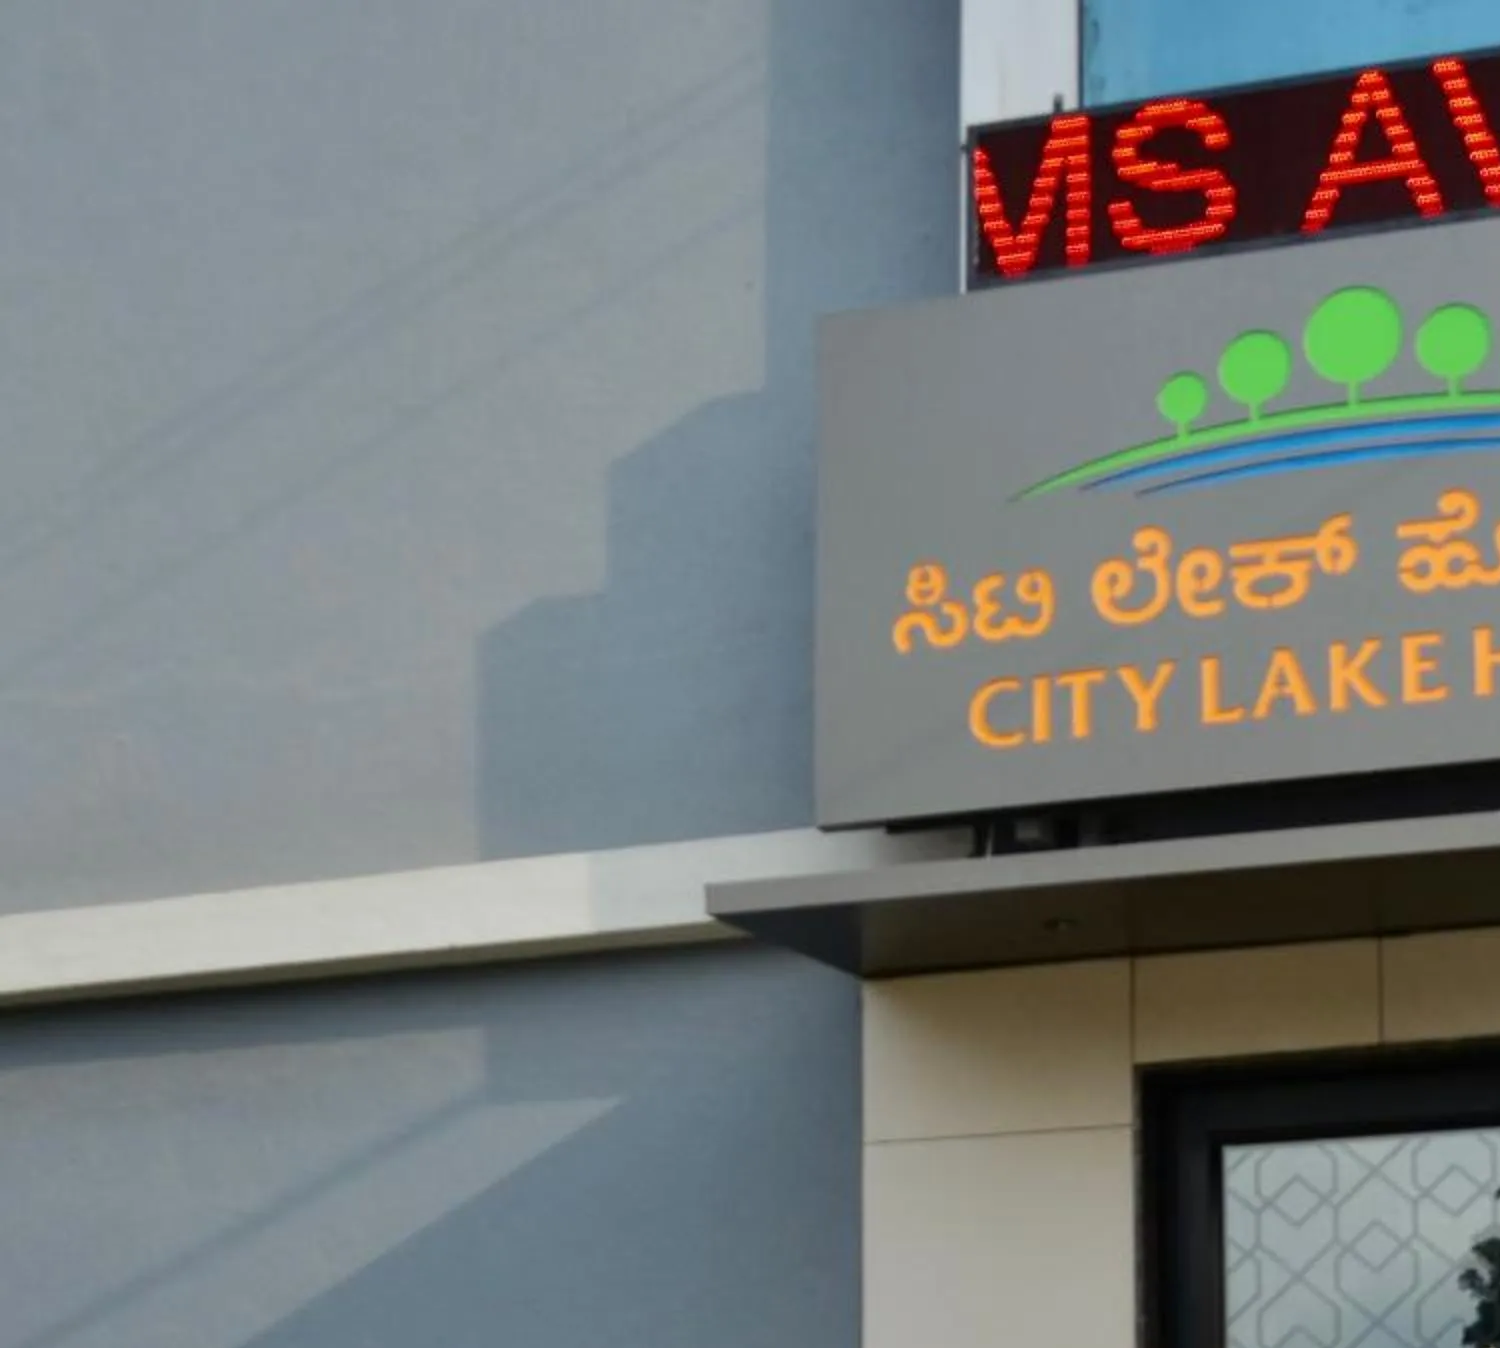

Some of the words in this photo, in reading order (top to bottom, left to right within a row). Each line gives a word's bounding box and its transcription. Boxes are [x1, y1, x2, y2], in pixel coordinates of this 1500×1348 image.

[891, 557, 1058, 655] ಸಿಟಿ
[1089, 511, 1361, 628] ಲೇಕ್
[966, 656, 1178, 751] CITY
[1198, 634, 1453, 728] LAKE
